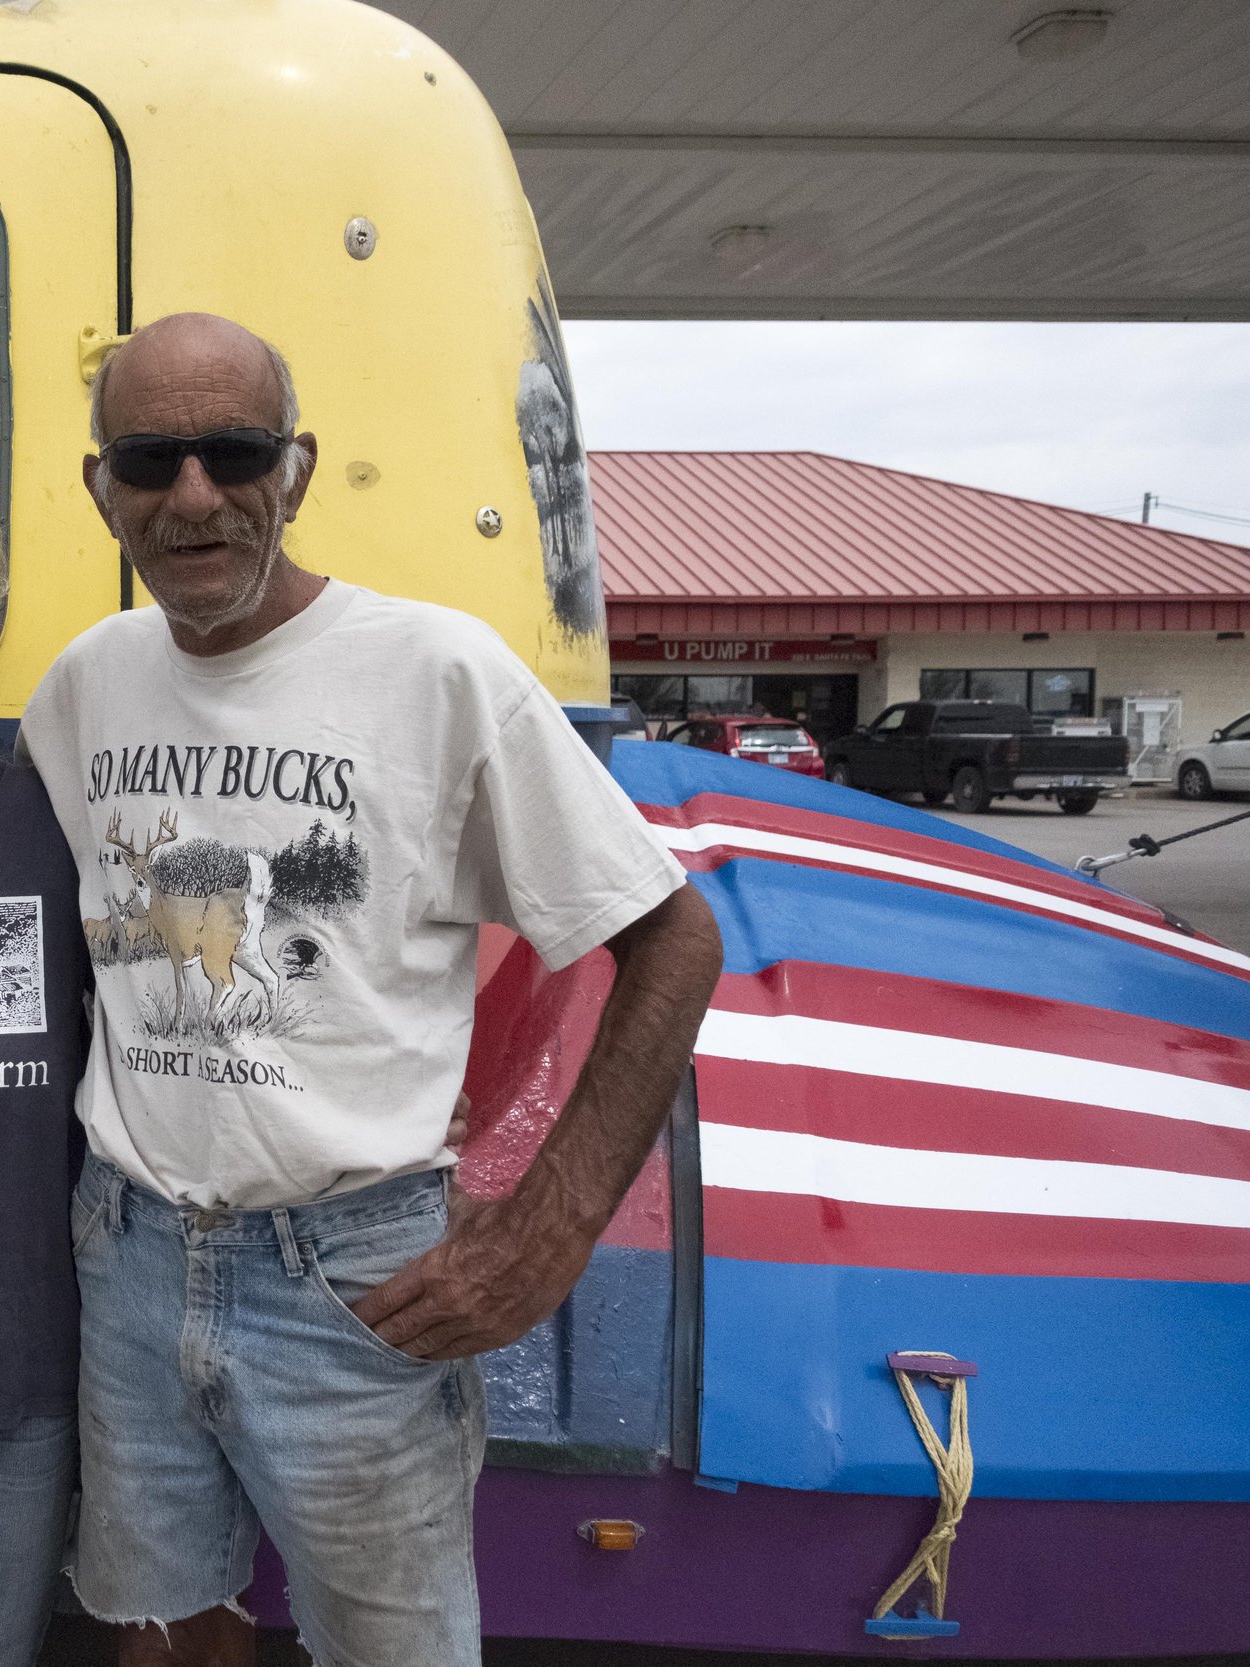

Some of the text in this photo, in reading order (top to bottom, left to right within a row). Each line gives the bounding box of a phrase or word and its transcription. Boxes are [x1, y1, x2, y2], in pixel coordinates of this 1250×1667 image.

[663, 641, 679, 660] U
[685, 641, 748, 660] PUMP
[754, 641, 775, 660] IT
[87, 744, 358, 822] SO MANY BUCKS,
[126, 1046, 194, 1077] SHORT
[204, 1056, 305, 1092] SEASON...
